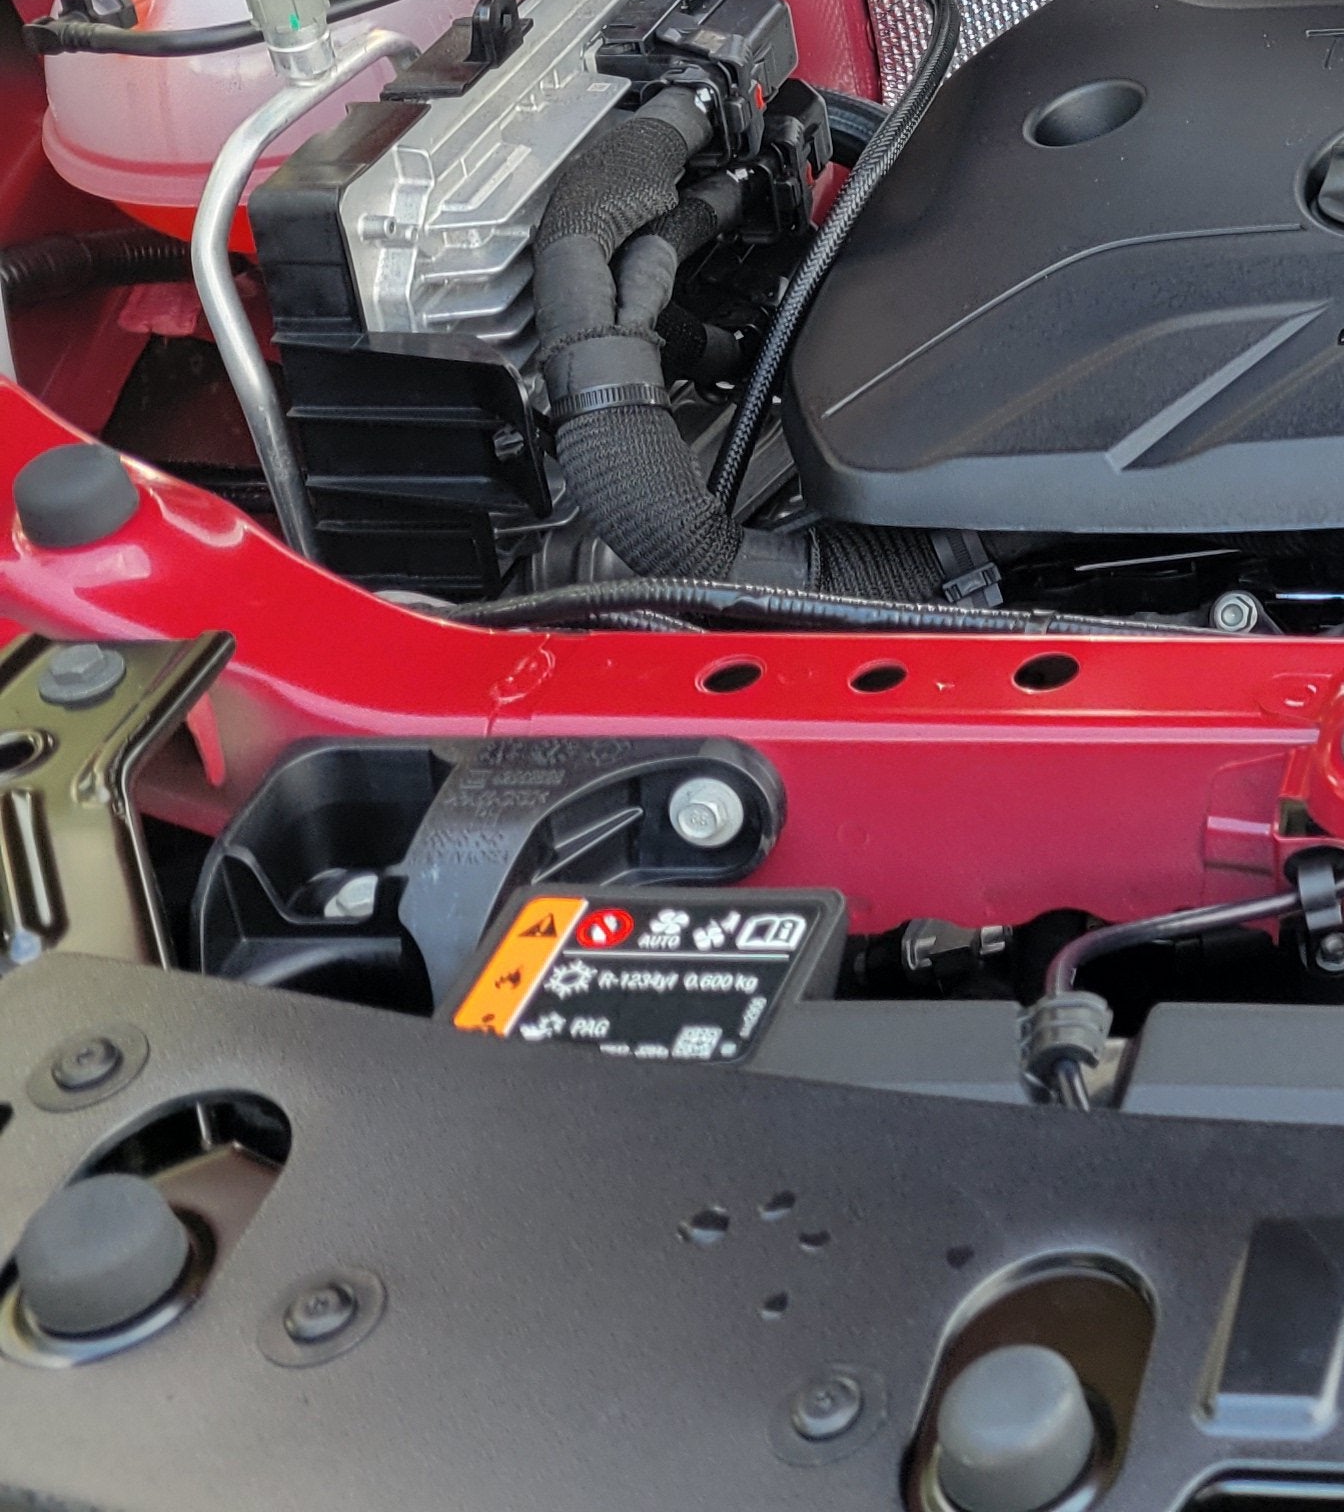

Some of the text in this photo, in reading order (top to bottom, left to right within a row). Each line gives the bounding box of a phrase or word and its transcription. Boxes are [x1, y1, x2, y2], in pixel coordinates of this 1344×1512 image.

[638, 932, 681, 949] AUTO
[599, 970, 758, 995] R-1234yf 0.600 kg
[570, 1016, 611, 1038] PAG
